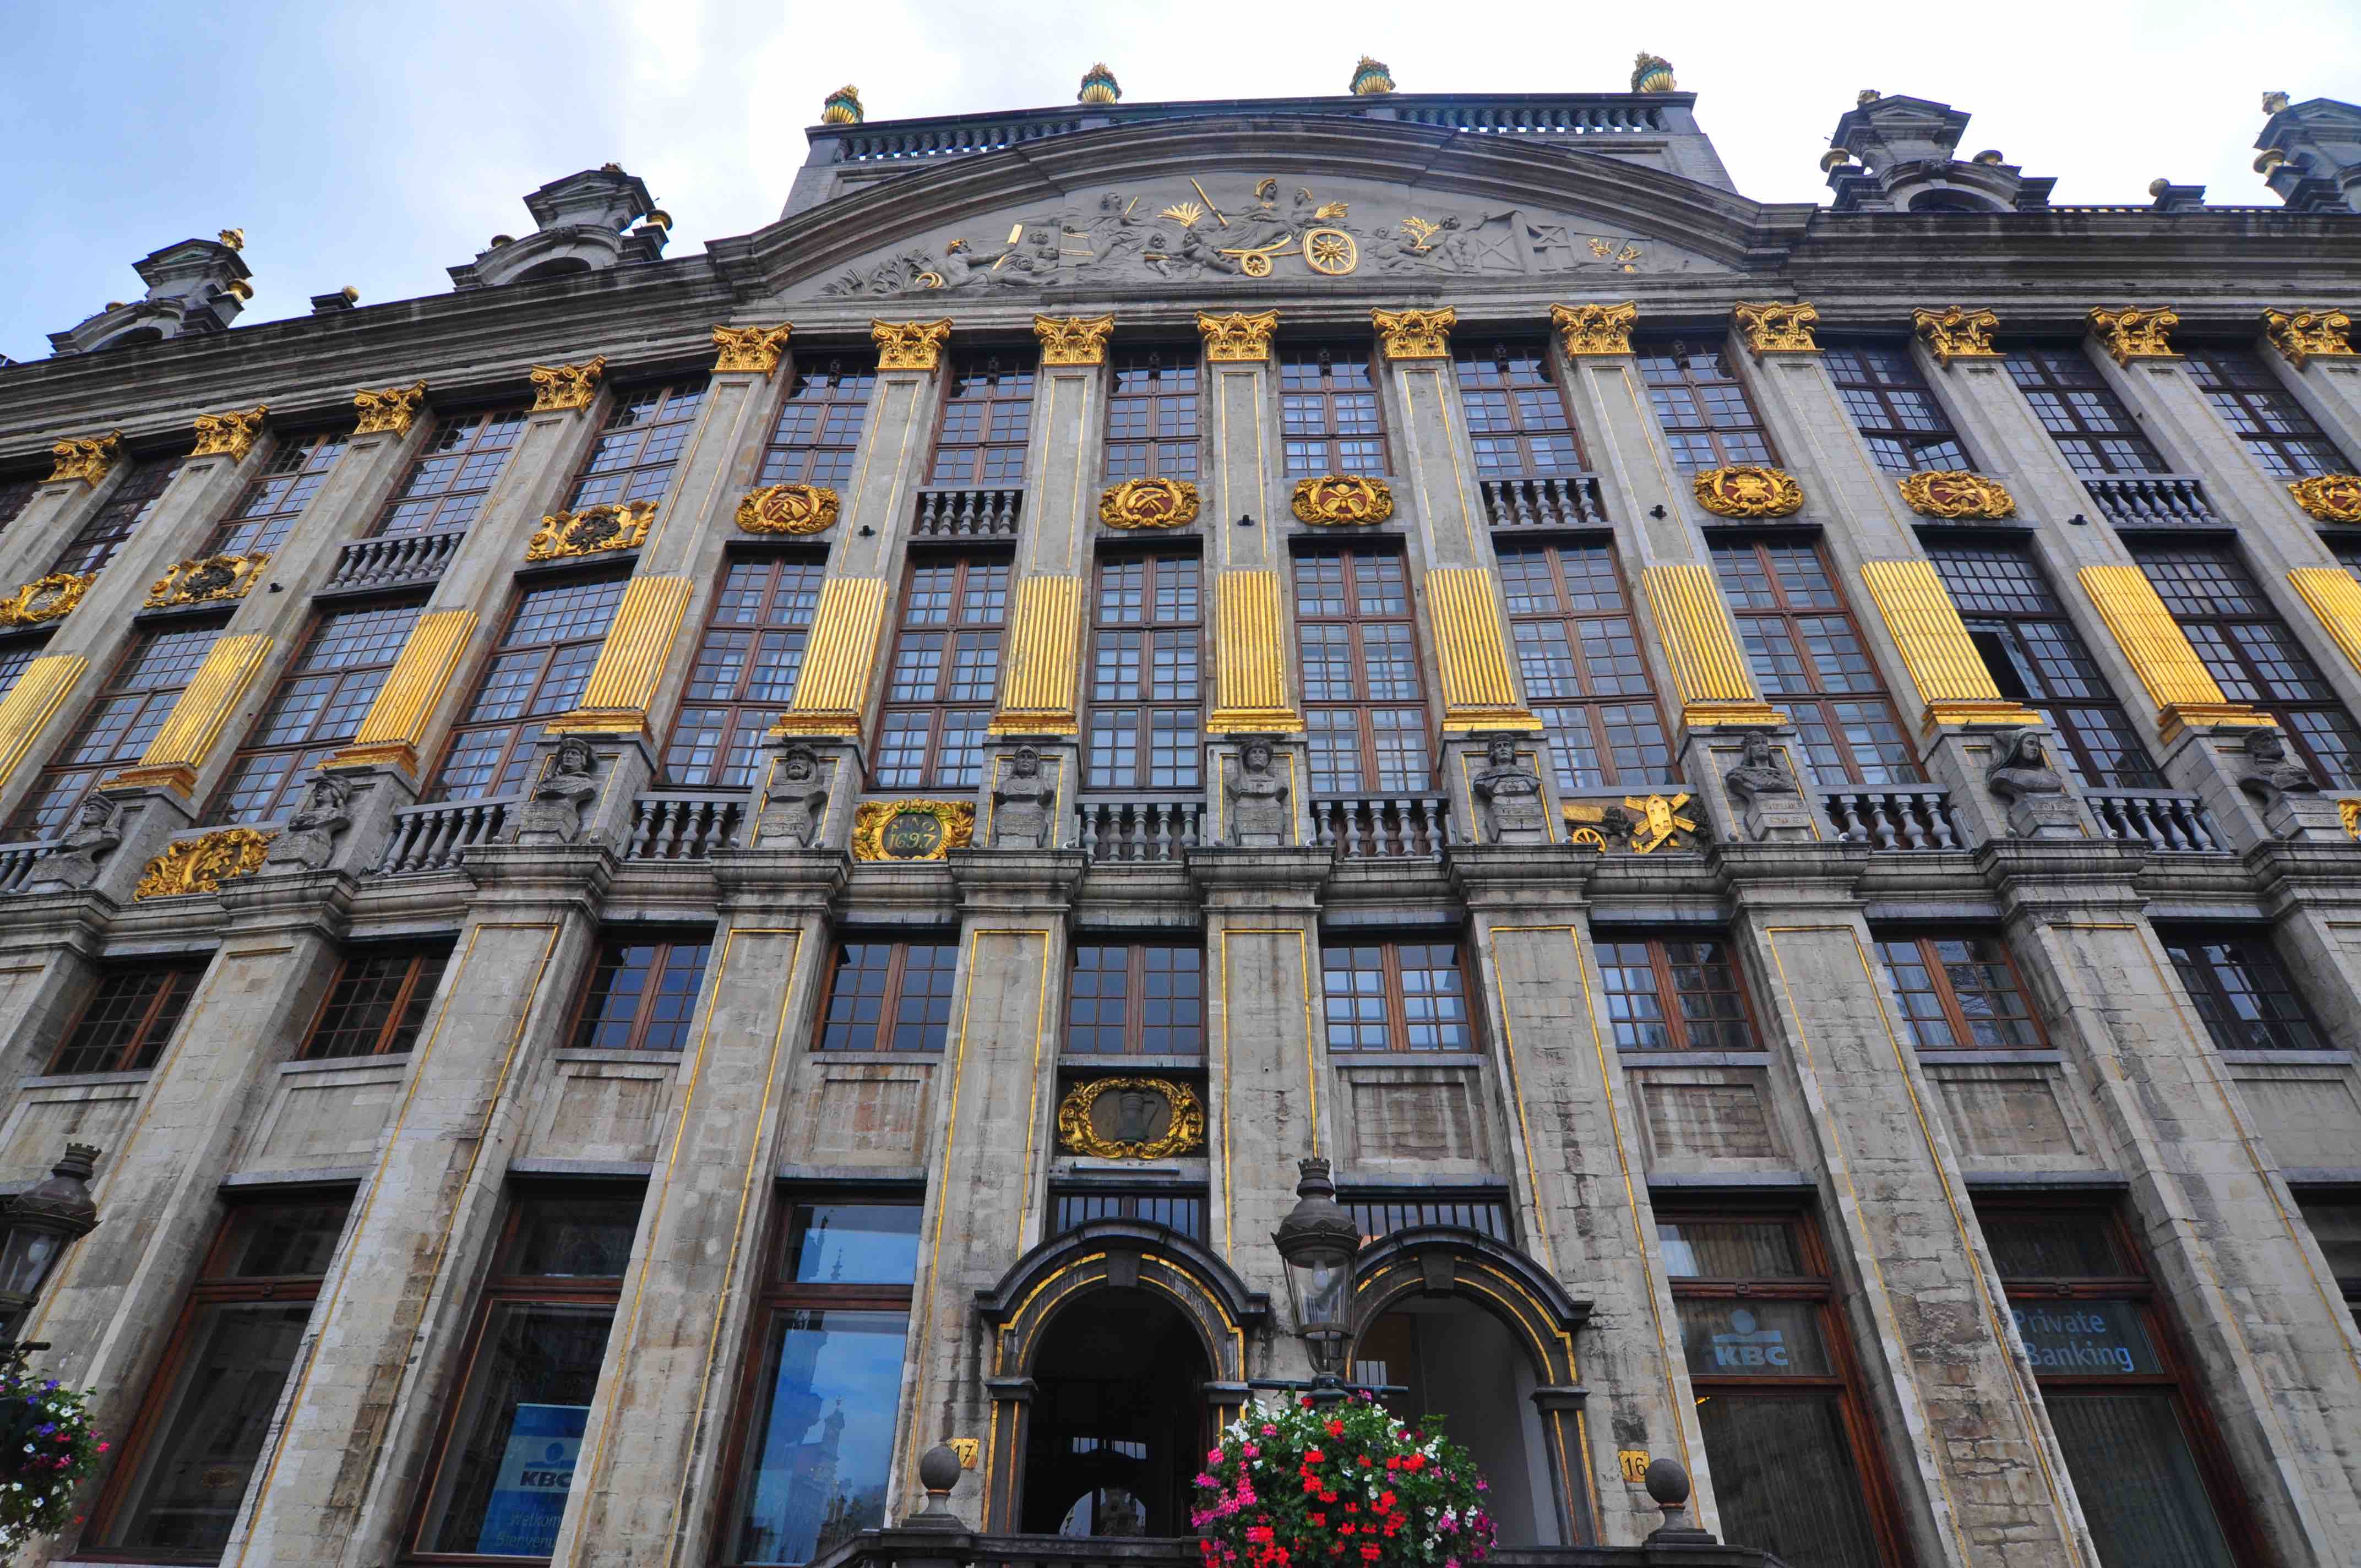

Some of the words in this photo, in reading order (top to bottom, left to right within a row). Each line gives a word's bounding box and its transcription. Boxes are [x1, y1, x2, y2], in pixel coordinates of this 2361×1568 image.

[889, 832, 937, 849] 1697
[2012, 1308, 2106, 1333] Private
[1715, 1347, 1788, 1365] KBC
[2023, 1340, 2134, 1372] Banking
[954, 1445, 973, 1463] 17
[1625, 1457, 1646, 1476] 16
[520, 1471, 573, 1487] KBC
